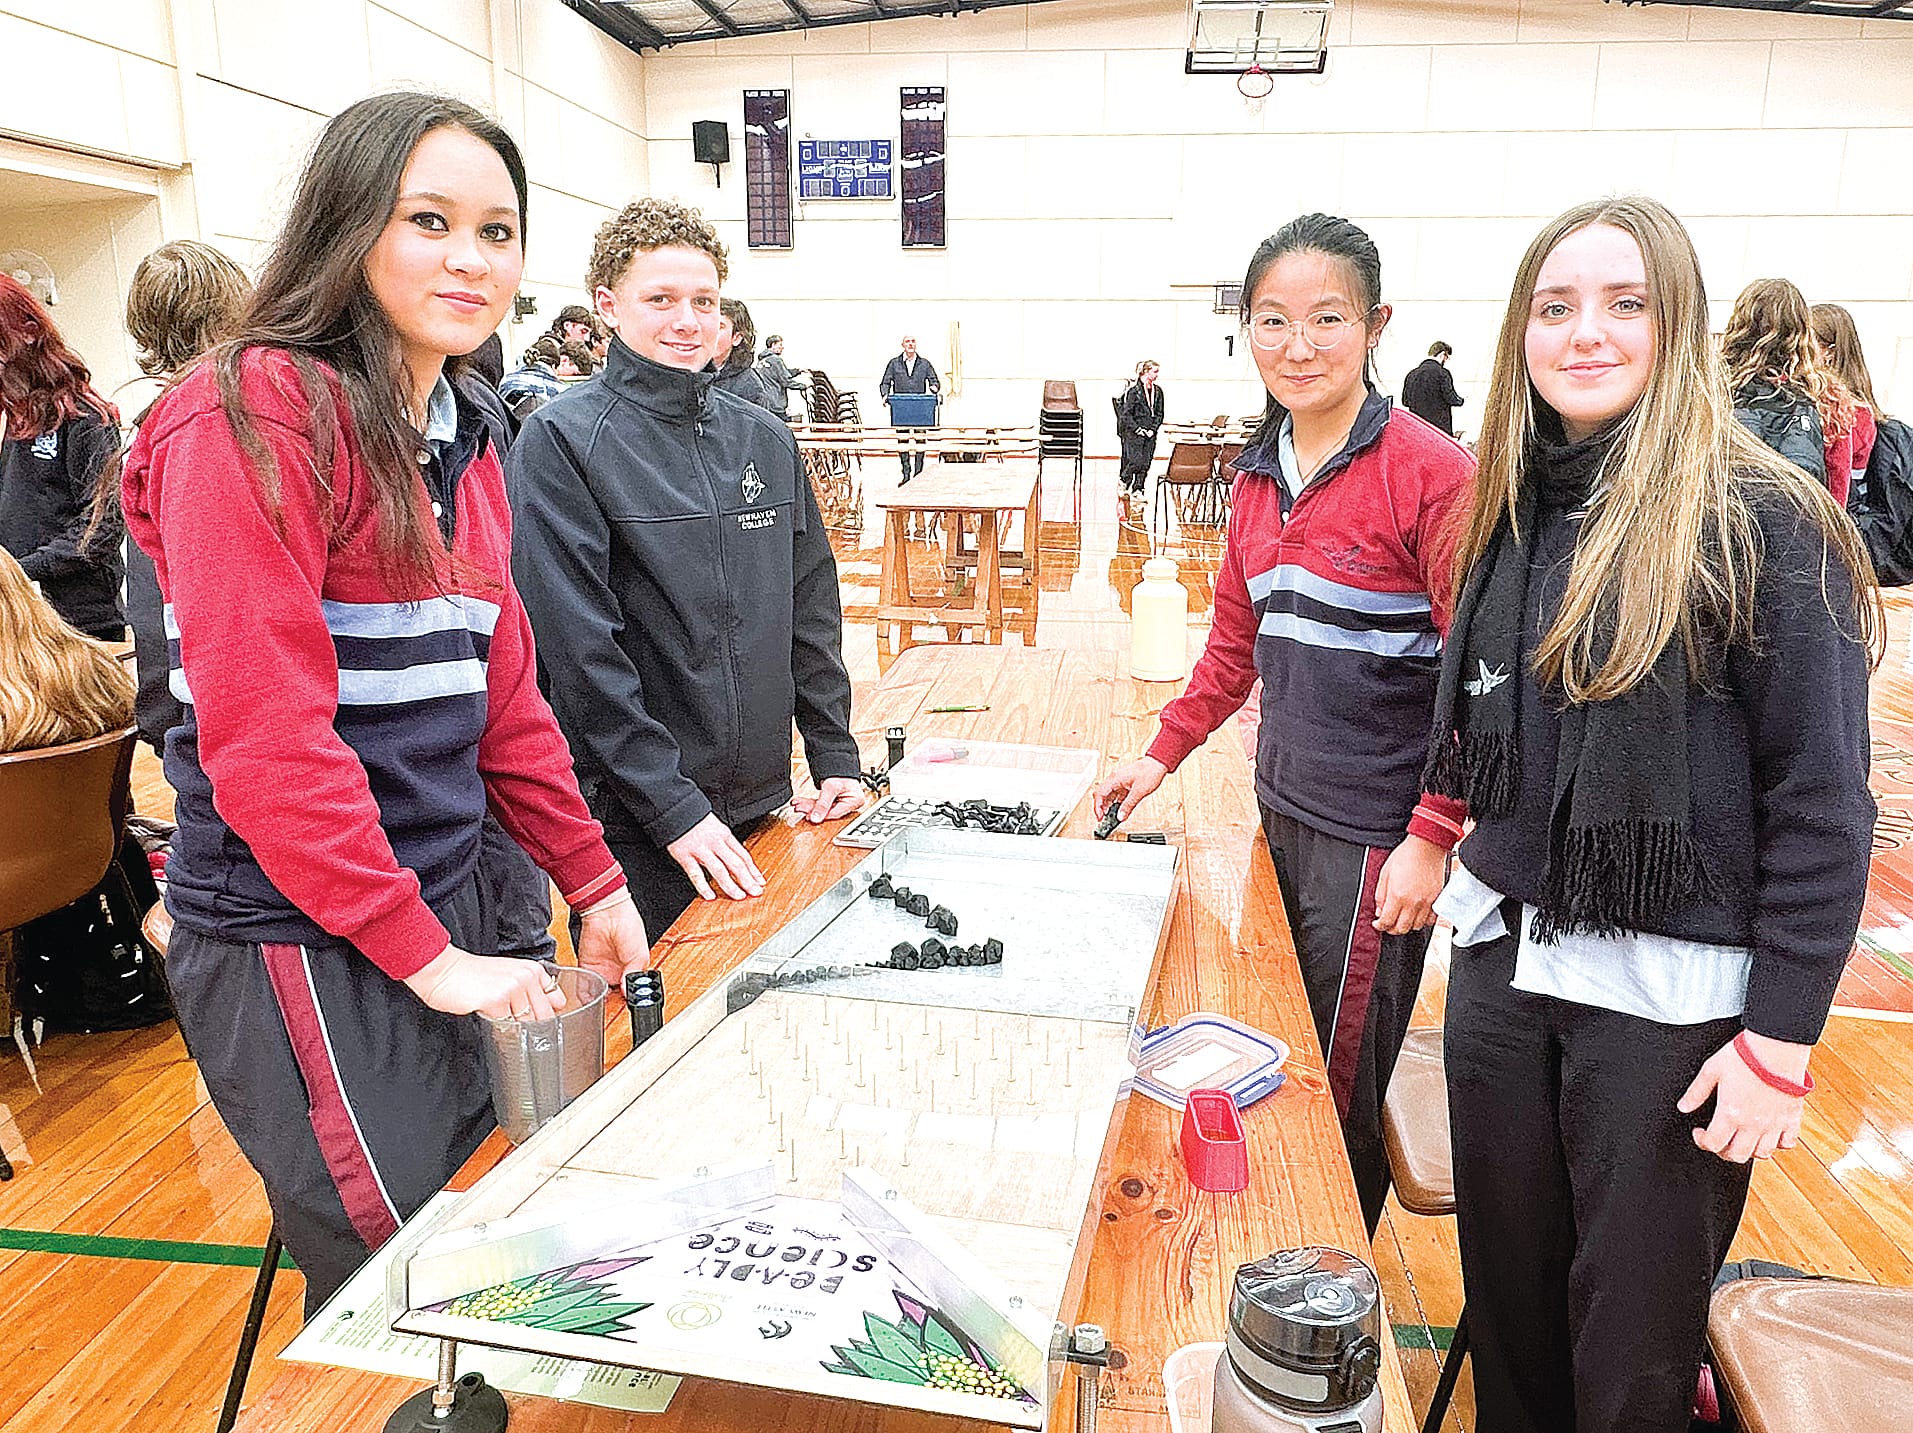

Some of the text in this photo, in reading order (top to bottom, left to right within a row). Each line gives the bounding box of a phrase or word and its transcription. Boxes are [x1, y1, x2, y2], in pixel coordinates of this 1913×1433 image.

[1225, 335, 1234, 357] 1
[738, 509, 776, 523] NEWHAVEN
[741, 518, 775, 530] COLLEGE
